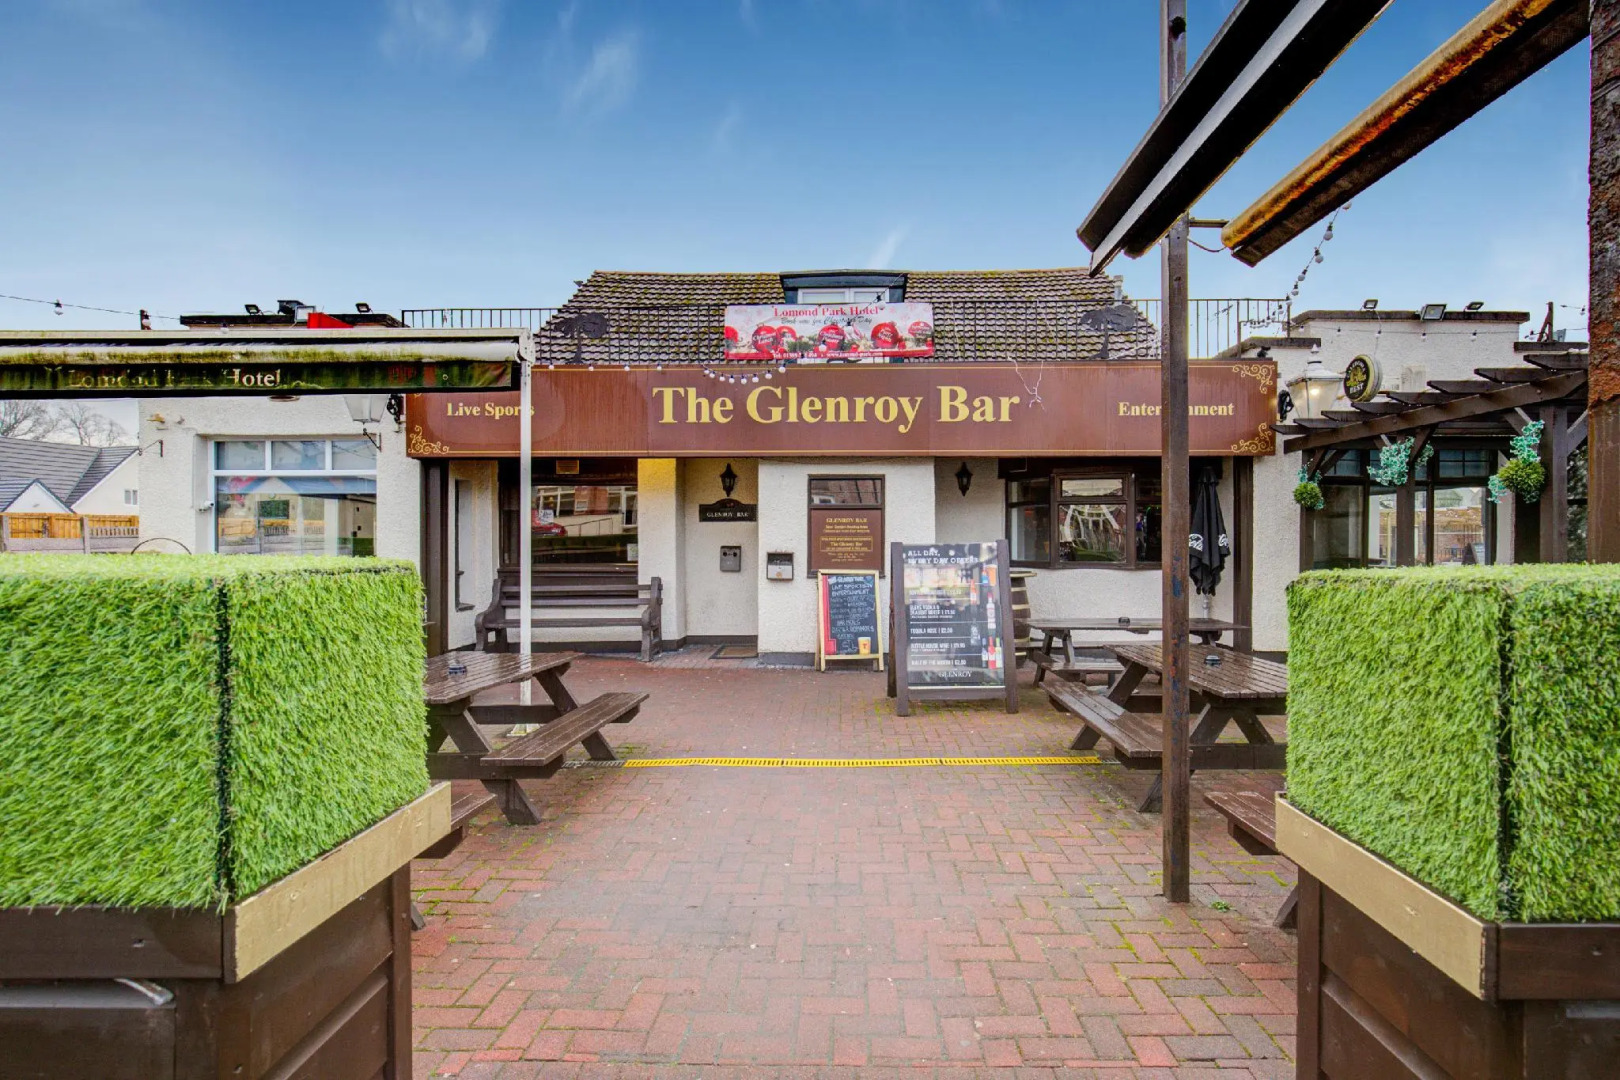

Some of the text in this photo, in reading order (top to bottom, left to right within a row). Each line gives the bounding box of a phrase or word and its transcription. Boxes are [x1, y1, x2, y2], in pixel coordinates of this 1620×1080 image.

[774, 305, 879, 317] Lomond Park Hotel
[446, 402, 535, 420] Live Spors
[652, 385, 1021, 434] The Glenroy Bar
[923, 549, 941, 557] DAY,
[938, 670, 972, 678] GLENROY
